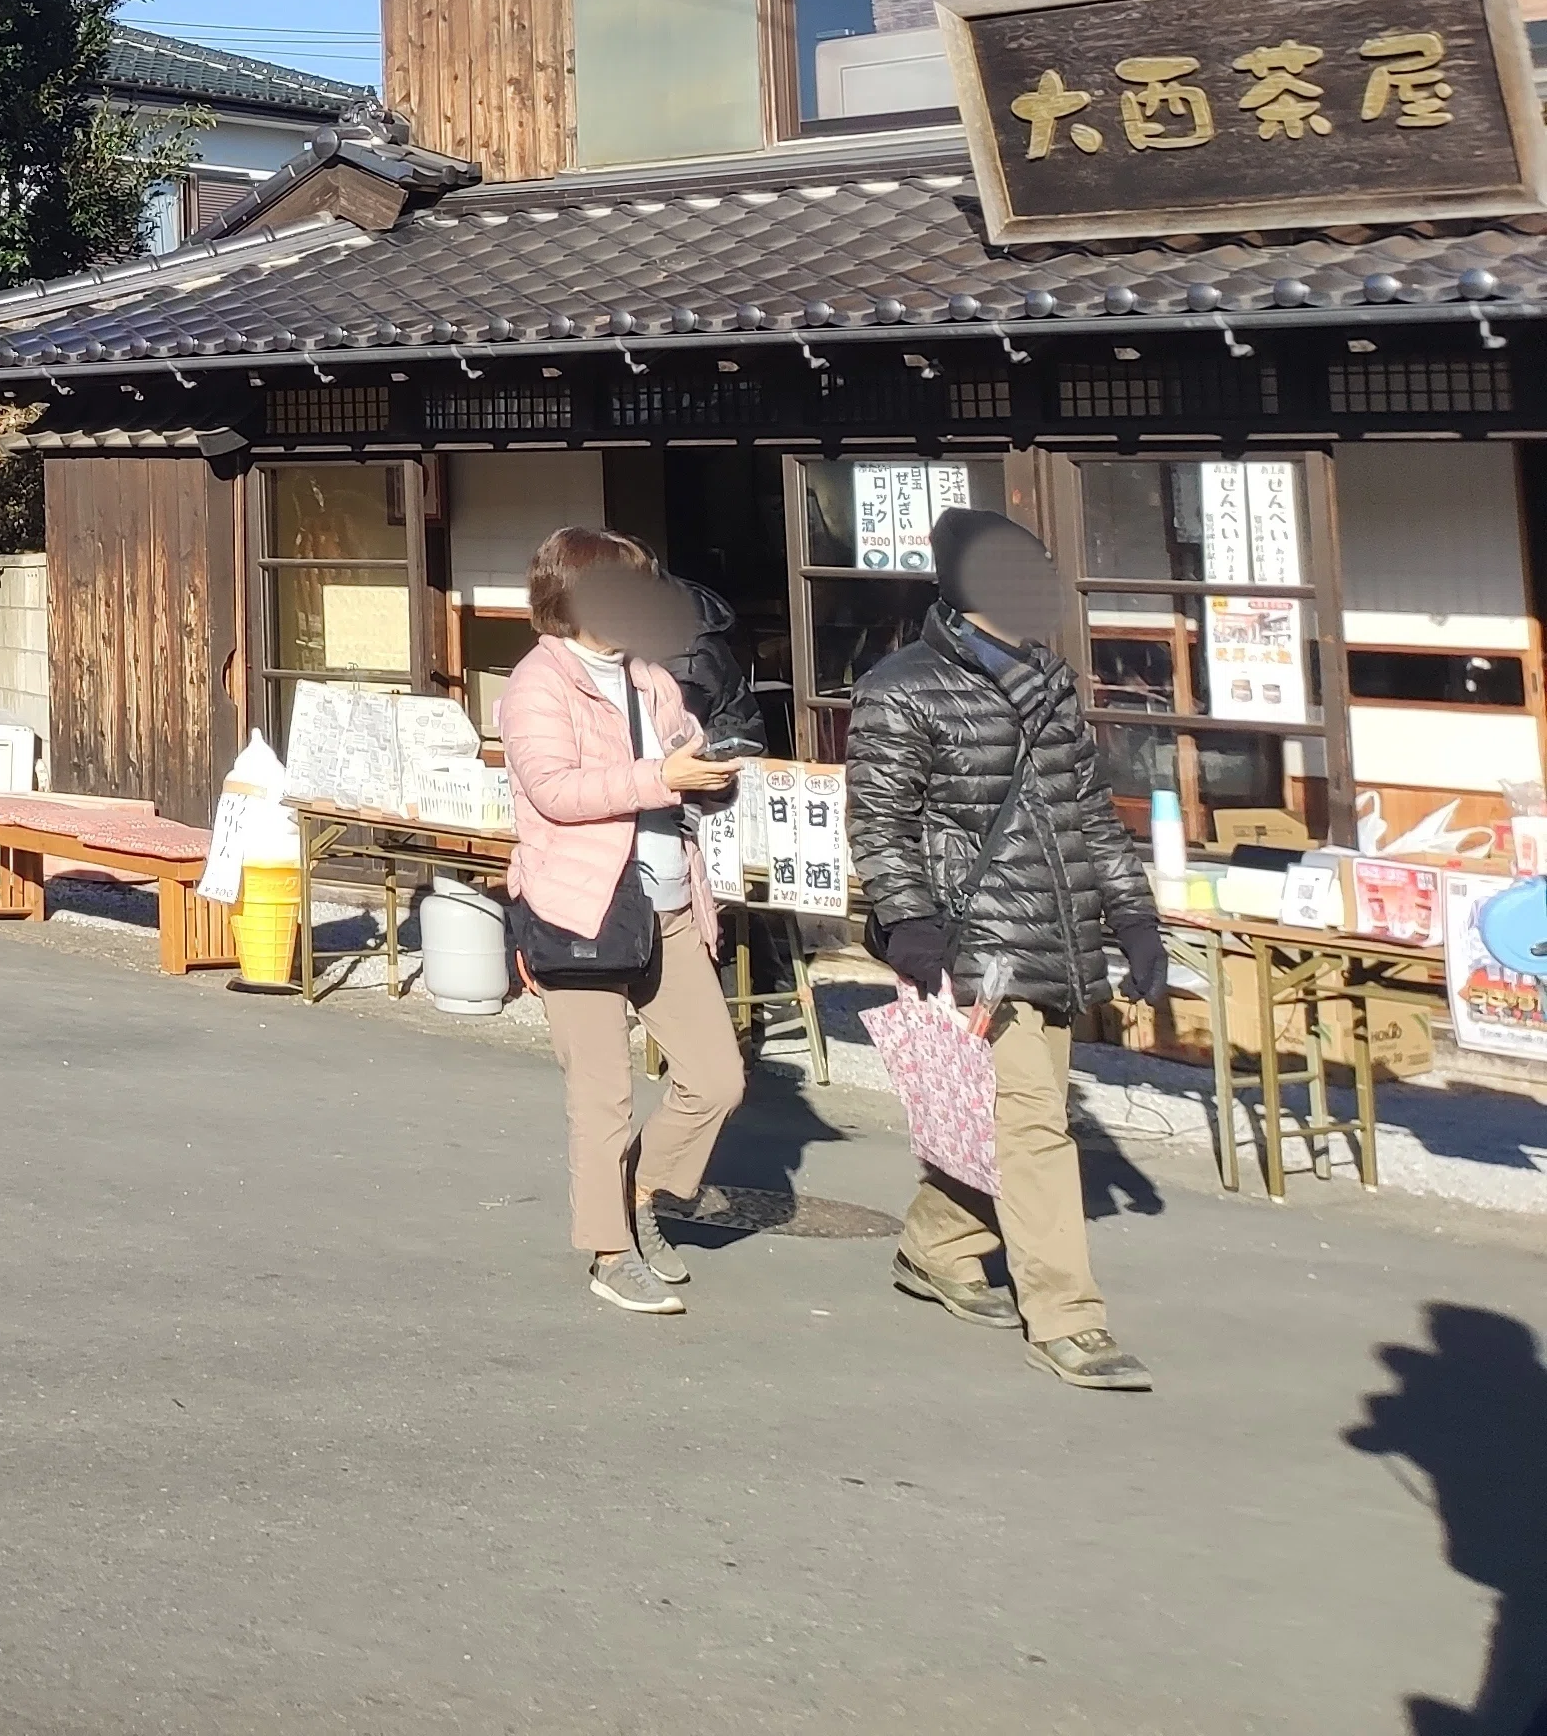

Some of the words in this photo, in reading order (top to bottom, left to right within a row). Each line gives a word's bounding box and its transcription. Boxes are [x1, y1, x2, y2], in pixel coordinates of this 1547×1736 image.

[1011, 31, 1454, 160] 大酉茶屋
[873, 476, 887, 524] ロック
[895, 471, 913, 530] ぜんざい
[911, 466, 923, 490] 白玉
[862, 502, 875, 533] 甘酒
[1220, 477, 1239, 540] せんべい
[1268, 478, 1289, 541] せんべい
[862, 536, 891, 546] ¥300
[768, 795, 795, 884] 甘酒
[805, 800, 831, 889] 甘酒
[813, 895, 842, 908] ¥200
